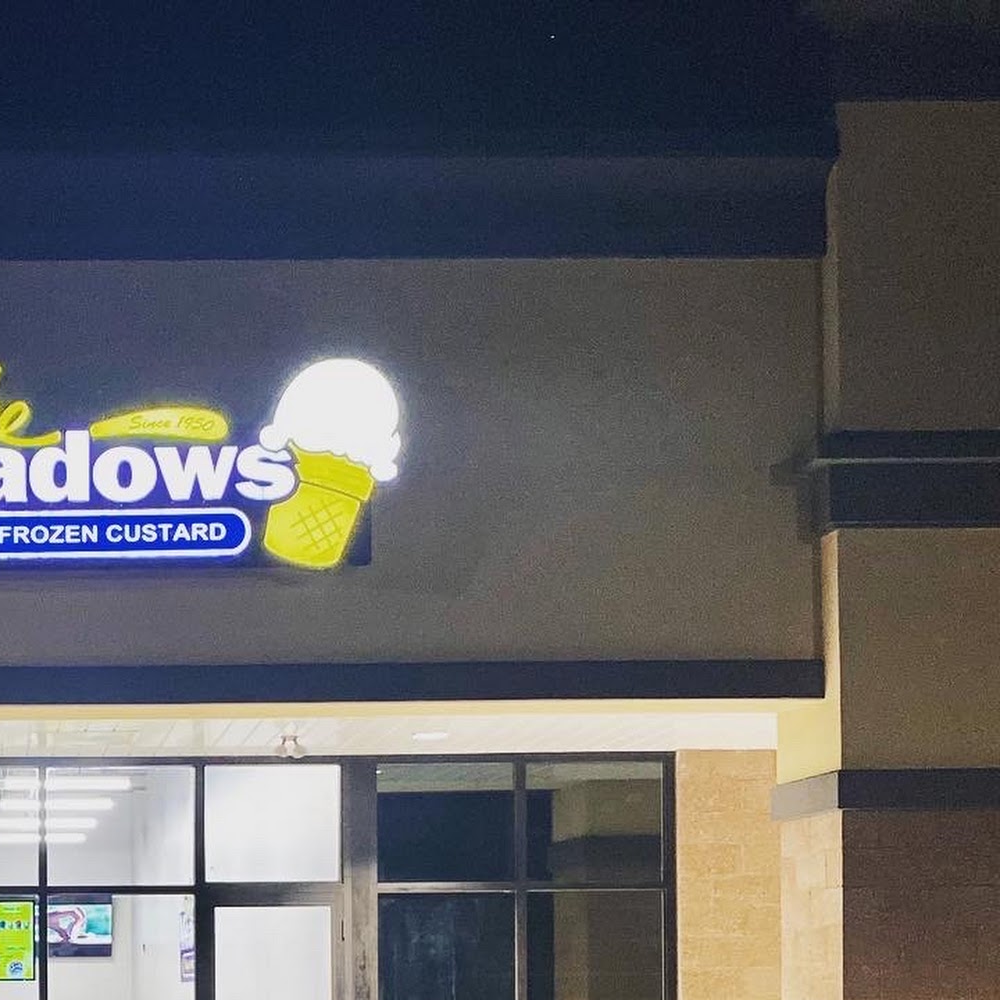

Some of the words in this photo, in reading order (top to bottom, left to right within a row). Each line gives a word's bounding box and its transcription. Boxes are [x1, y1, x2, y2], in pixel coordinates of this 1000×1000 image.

[129, 414, 172, 430] Since
[177, 415, 214, 431] 1950
[106, 522, 226, 543] CUSTARD
